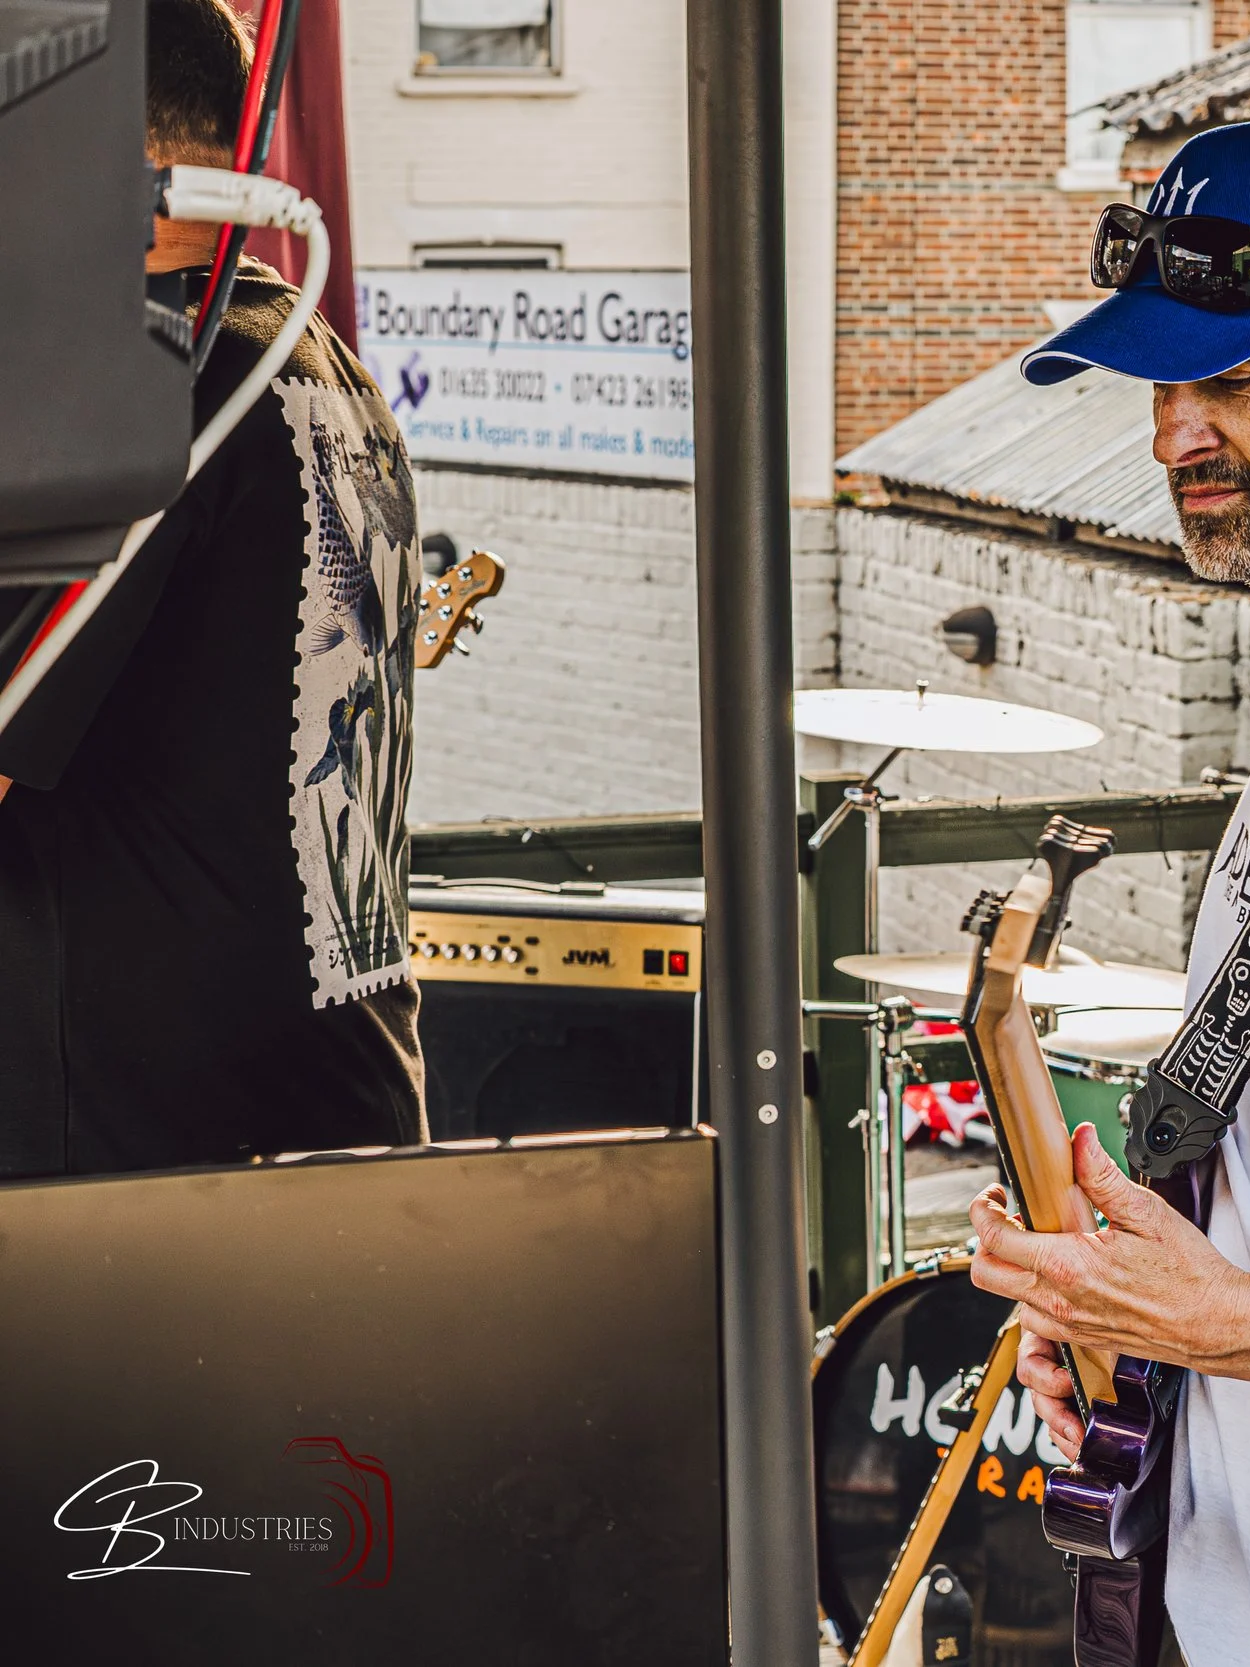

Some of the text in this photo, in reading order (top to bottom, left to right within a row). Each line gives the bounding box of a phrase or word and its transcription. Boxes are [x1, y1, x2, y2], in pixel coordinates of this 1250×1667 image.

[376, 289, 689, 361] Boundary Road Garag
[459, 416, 471, 442] &
[475, 416, 529, 450] Repairs
[534, 428, 551, 448] on
[557, 424, 573, 451] all
[579, 426, 627, 454] makes
[631, 426, 645, 455] &
[562, 948, 610, 965] JVM
